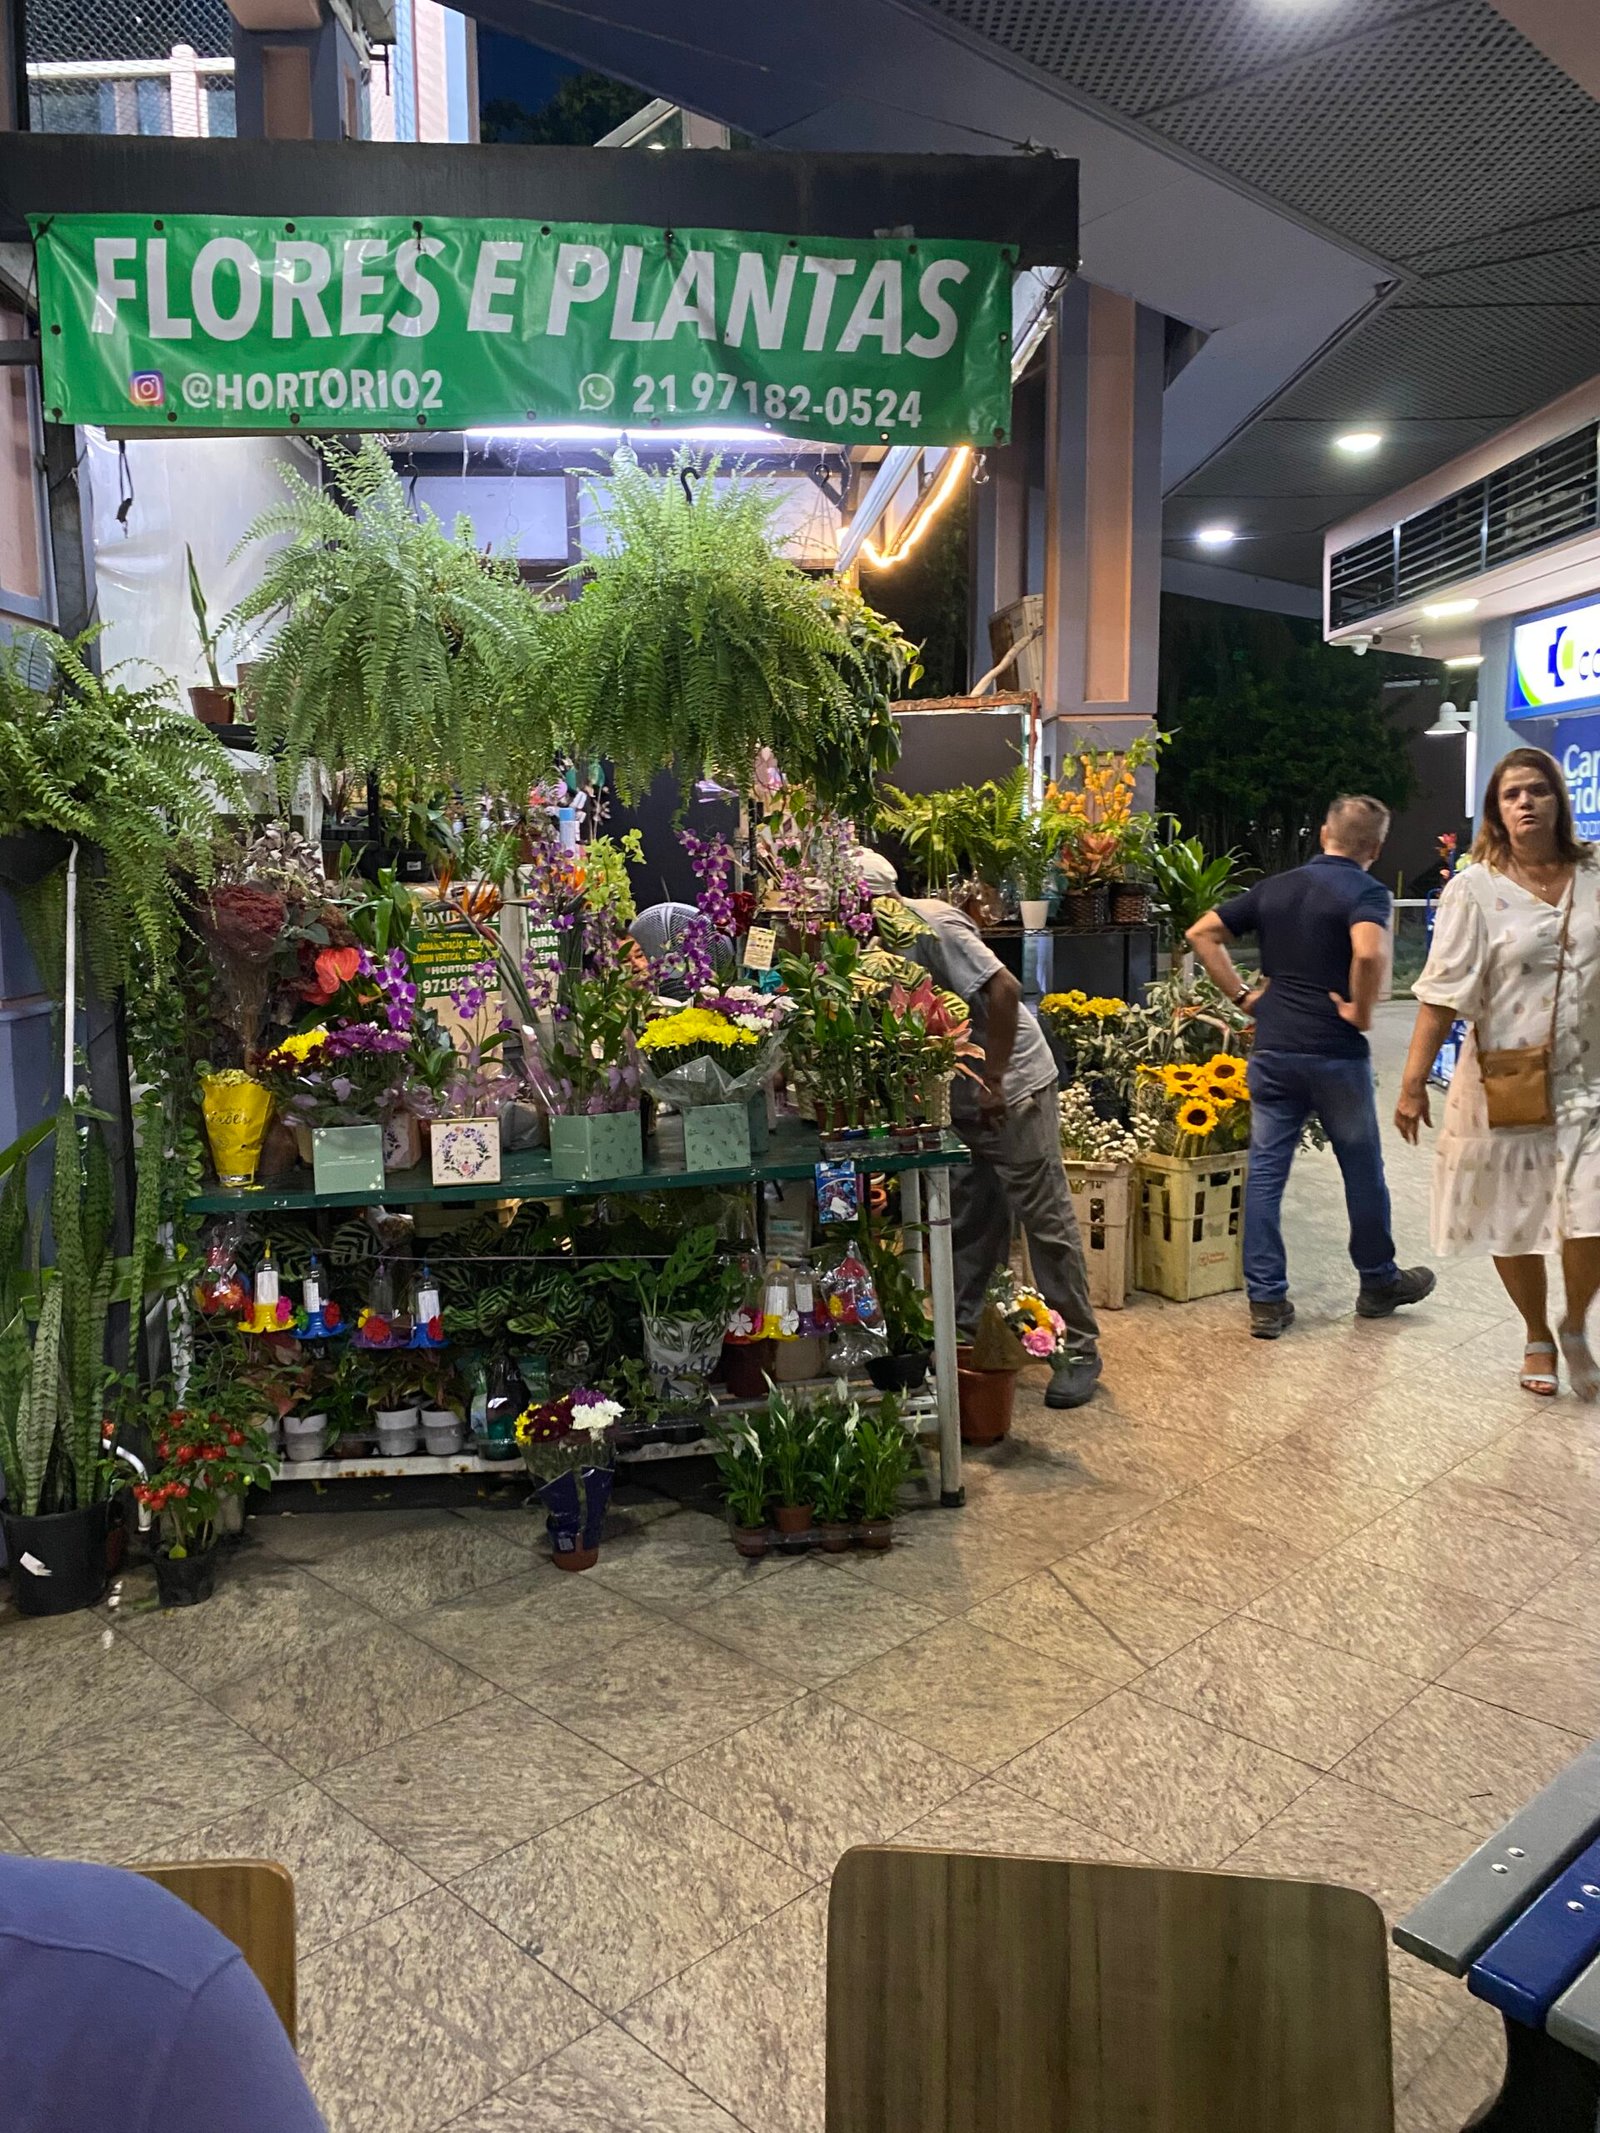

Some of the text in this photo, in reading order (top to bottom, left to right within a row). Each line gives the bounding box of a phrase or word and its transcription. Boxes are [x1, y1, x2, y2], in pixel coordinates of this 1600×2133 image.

[91, 236, 970, 360] FLORES E PLANTAS
[632, 373, 922, 428] 21 97182-0524
